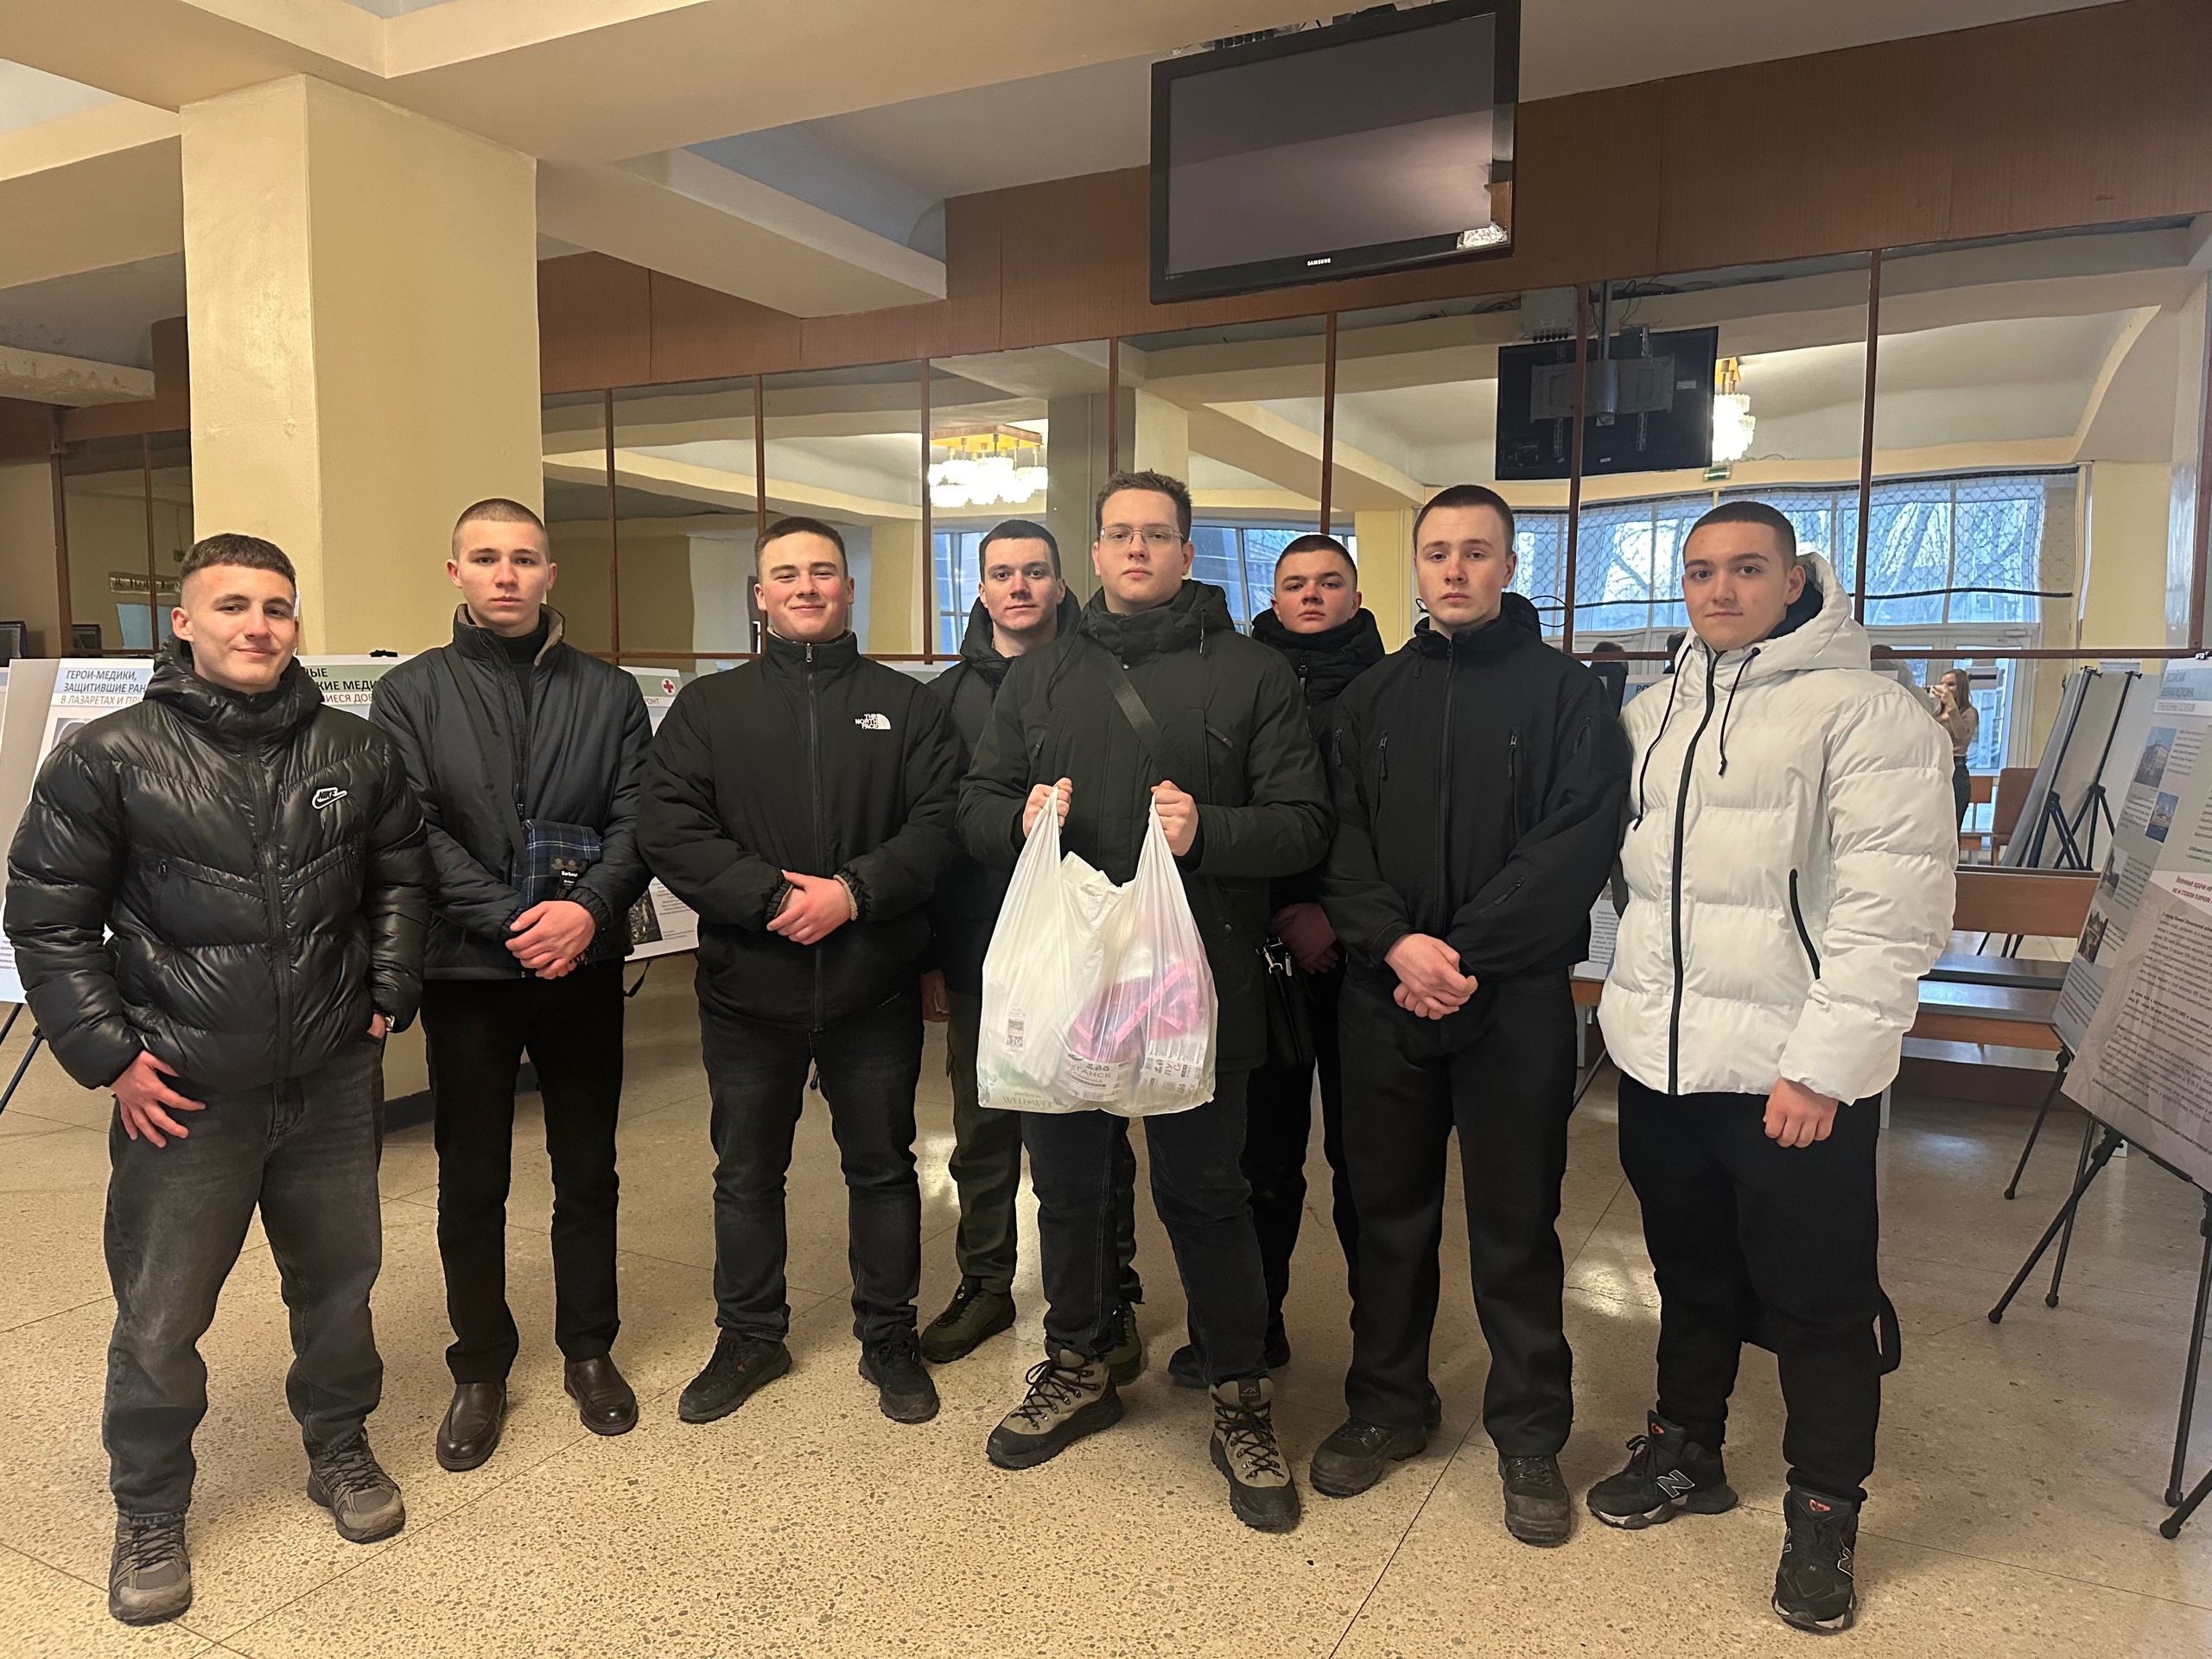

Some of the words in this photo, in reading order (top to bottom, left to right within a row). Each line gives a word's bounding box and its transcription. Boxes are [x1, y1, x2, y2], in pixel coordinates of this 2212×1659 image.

[1306, 257, 1332, 266] SAMSUNG
[66, 670, 137, 681] ГЕРОИ-МЕДИКИ,
[63, 683, 127, 693] ЗАЩИТИВШИЕ
[60, 695, 67, 704] В
[67, 695, 115, 705] ЛАЗАРЕТАХ
[117, 696, 124, 705] И
